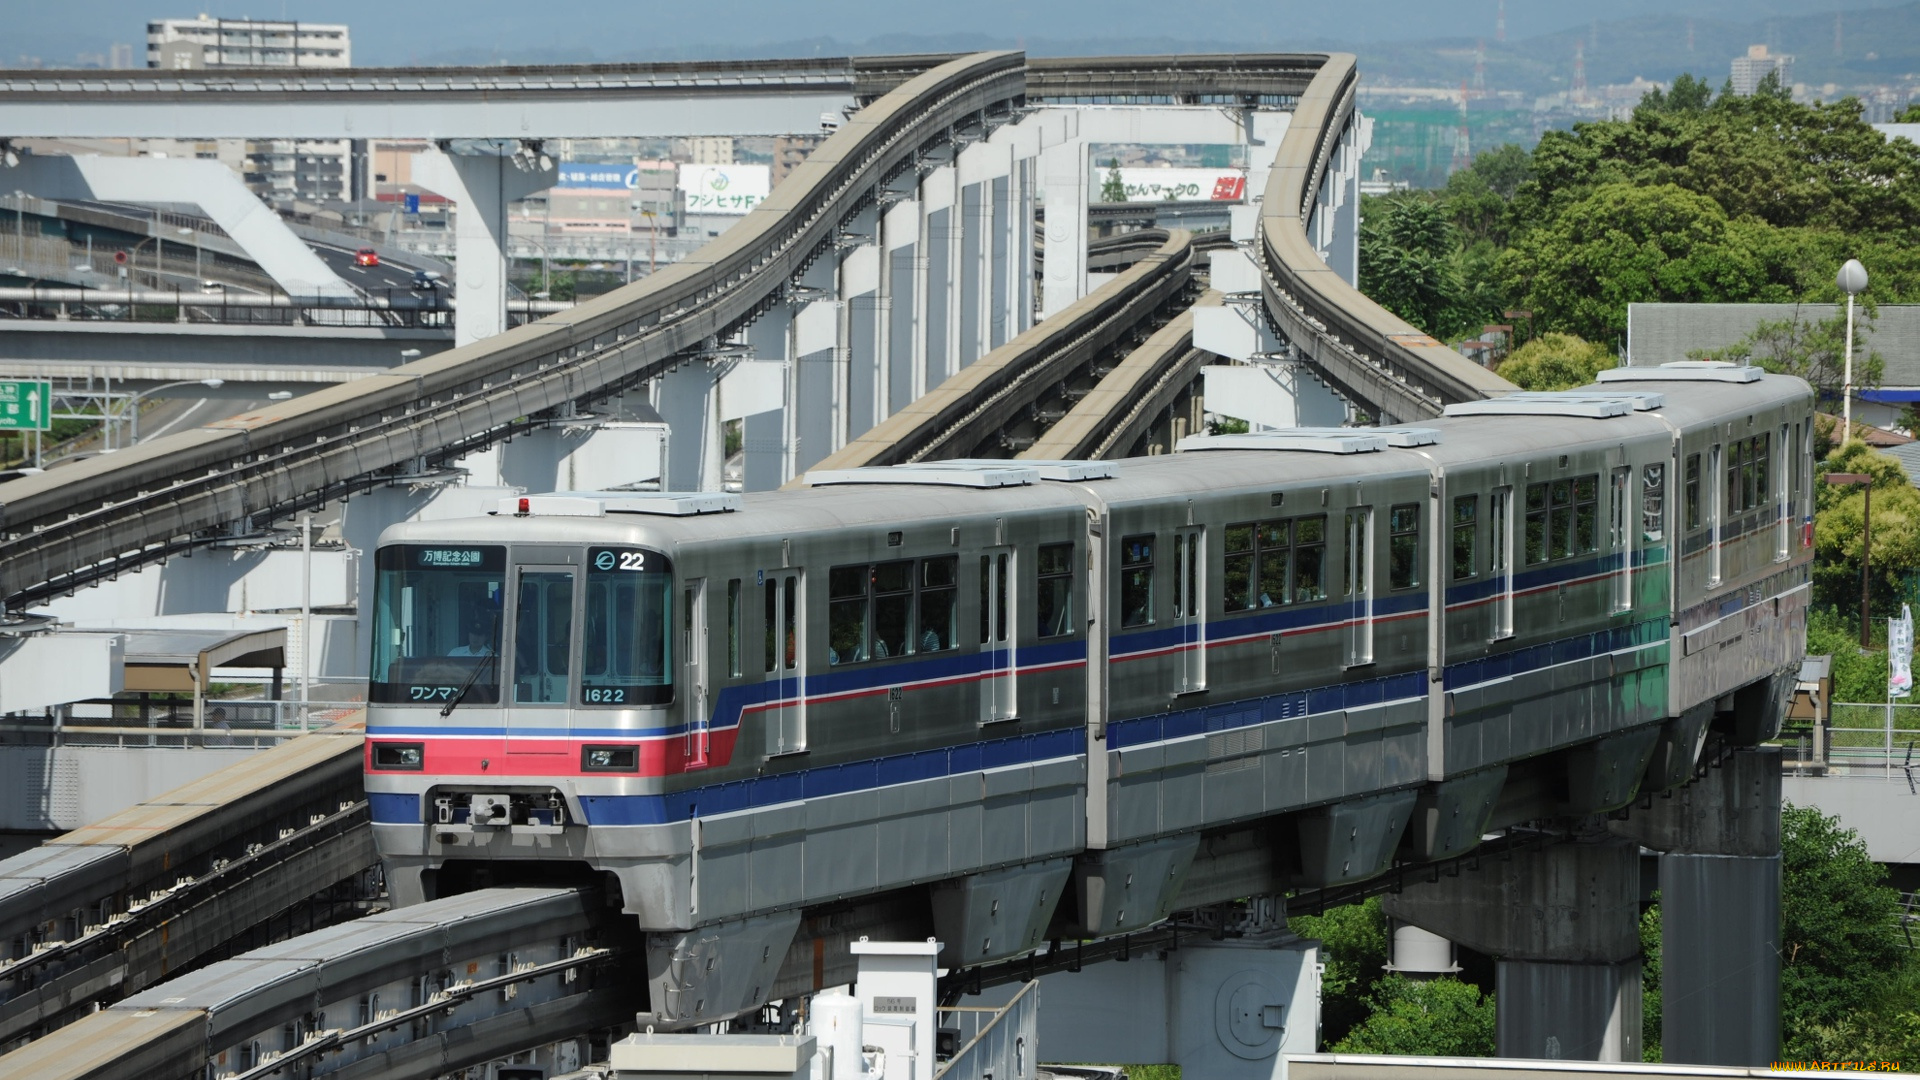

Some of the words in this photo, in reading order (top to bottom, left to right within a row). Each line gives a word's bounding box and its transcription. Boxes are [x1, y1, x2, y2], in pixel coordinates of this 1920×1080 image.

[423, 550, 481, 563] 万博記念公園
[619, 552, 644, 571] 22
[585, 689, 624, 703] 1622
